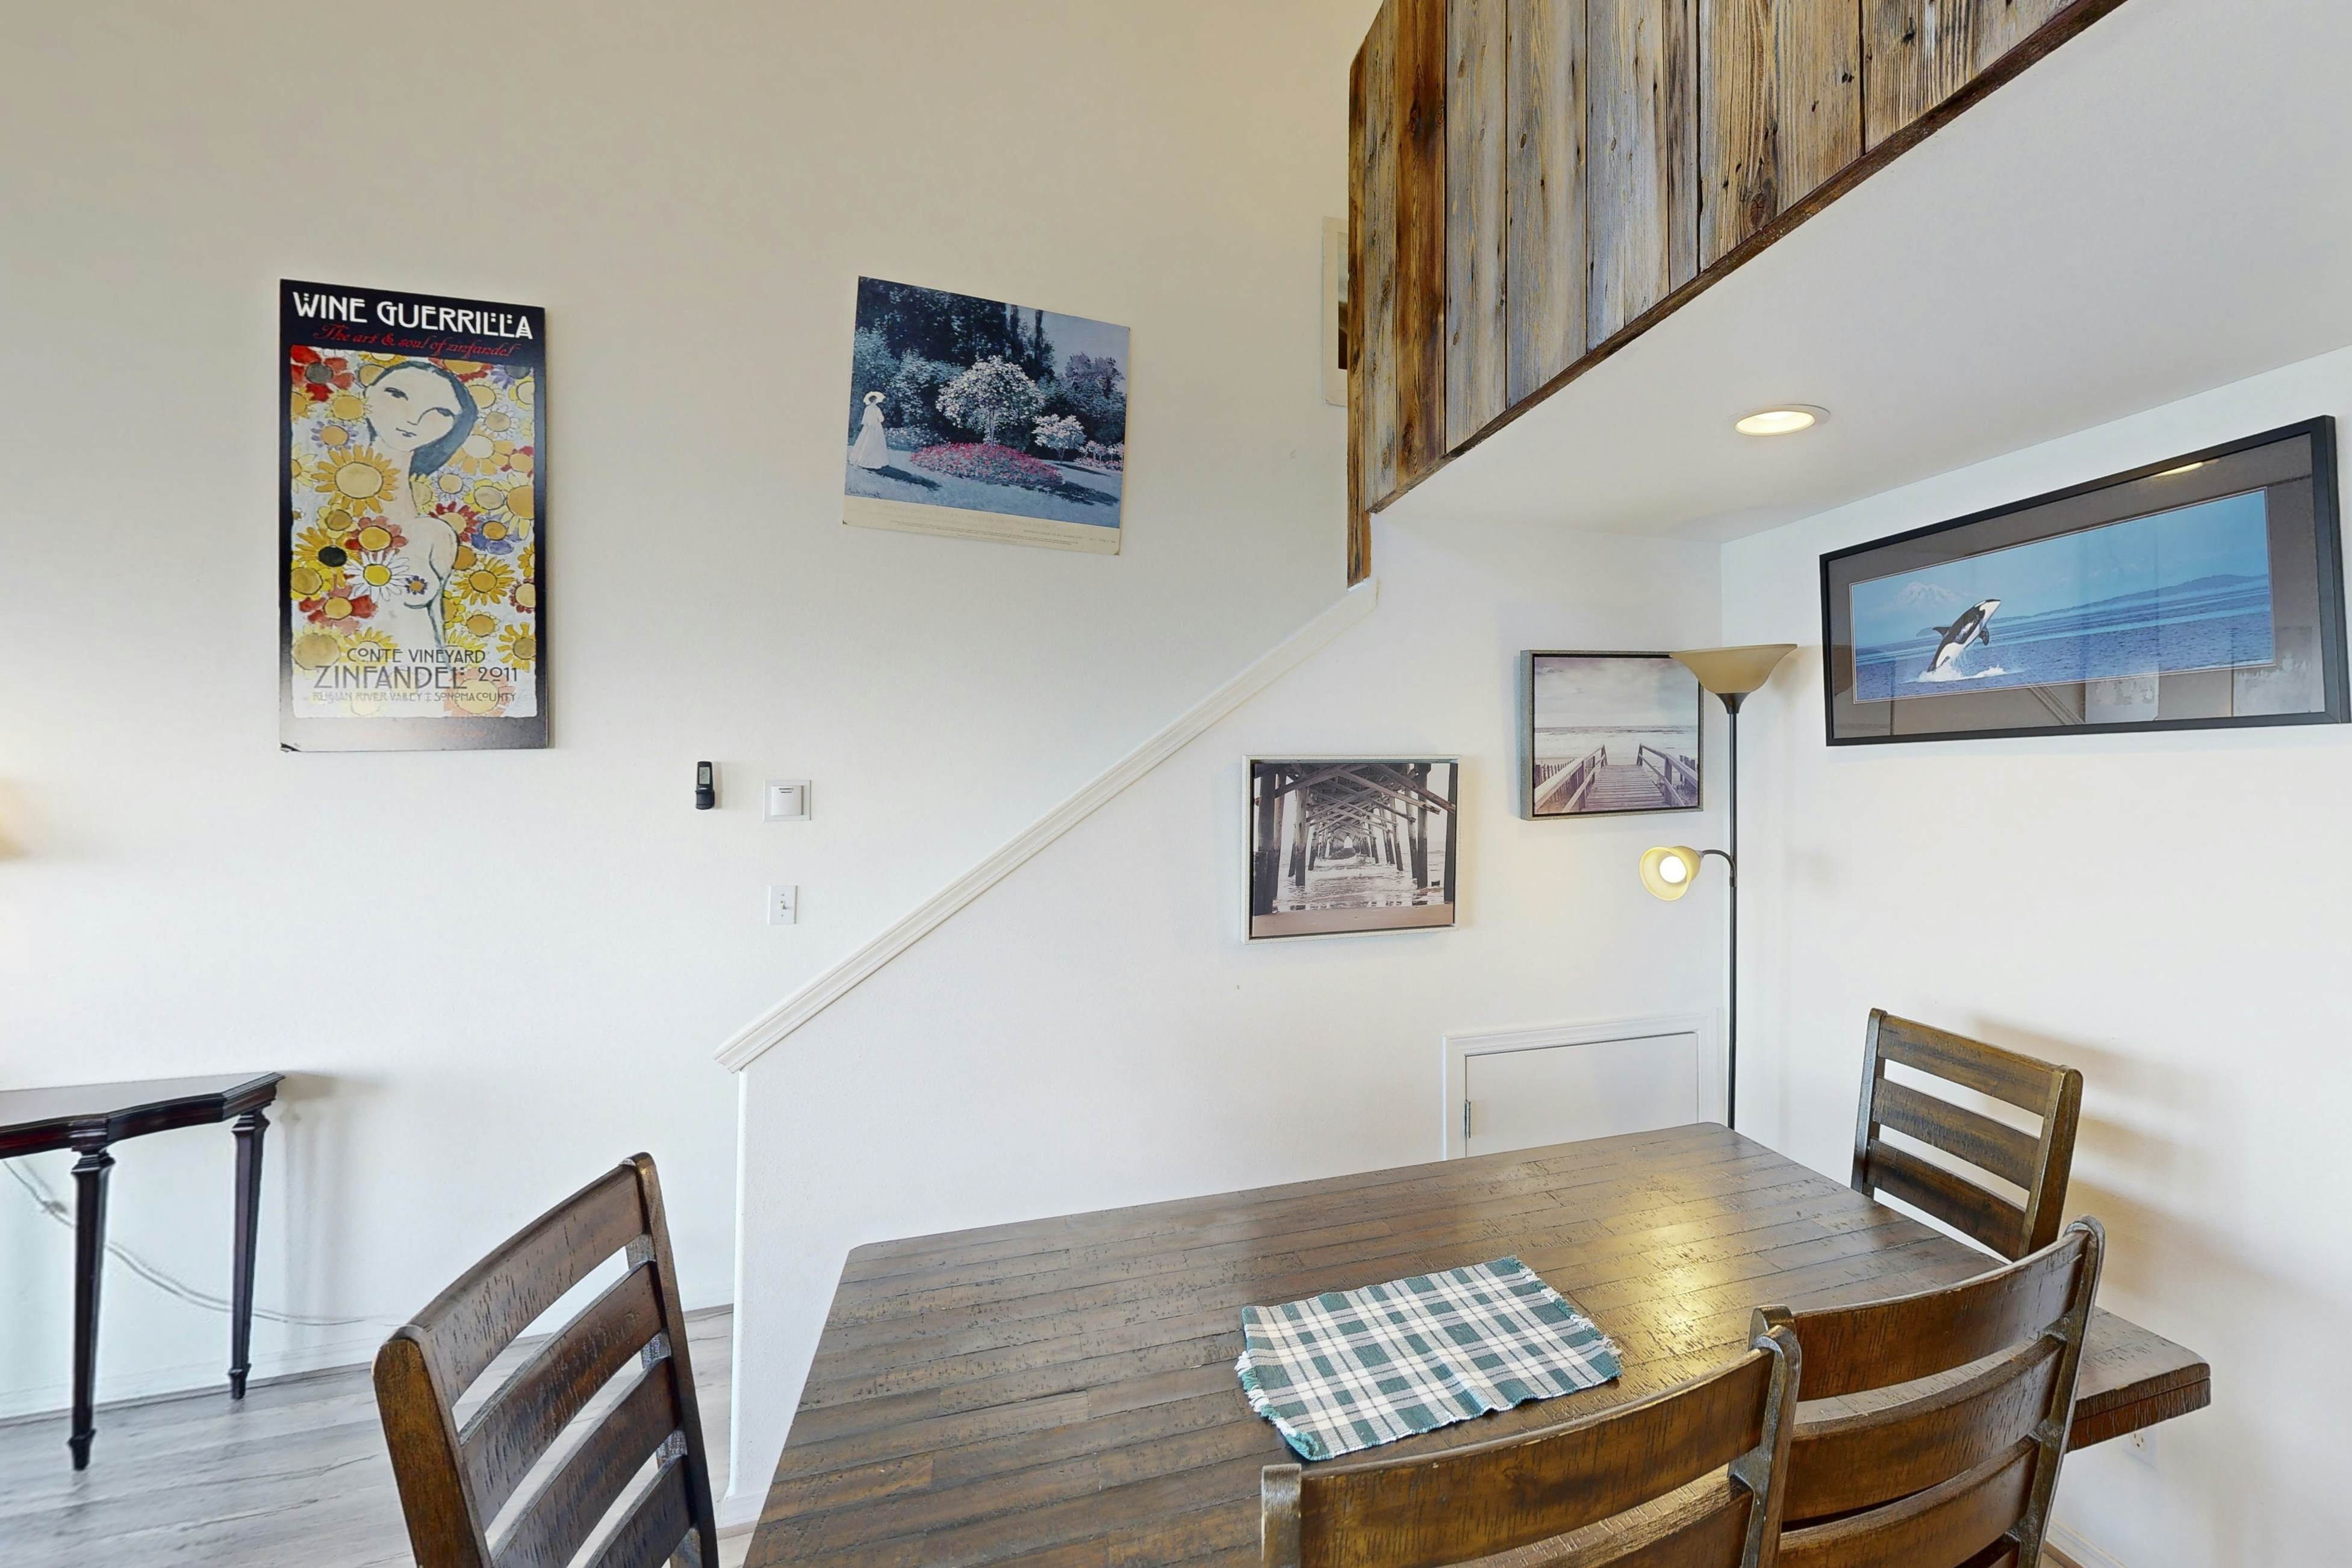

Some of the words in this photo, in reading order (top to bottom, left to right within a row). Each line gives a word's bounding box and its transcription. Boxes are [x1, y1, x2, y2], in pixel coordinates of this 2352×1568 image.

[293, 291, 367, 323] WINE
[376, 301, 534, 340] GUERRILLA
[313, 324, 350, 341] The
[381, 333, 396, 346] &
[398, 335, 436, 348] soul
[429, 337, 453, 356] of
[347, 648, 403, 662] CONTE
[408, 649, 486, 664] VINEYARD
[313, 665, 467, 689] ZINFANDEL
[478, 667, 517, 682] 2011
[356, 691, 388, 702] RIVER
[434, 692, 475, 702] SONOMA
[476, 692, 516, 702] COUNTY
